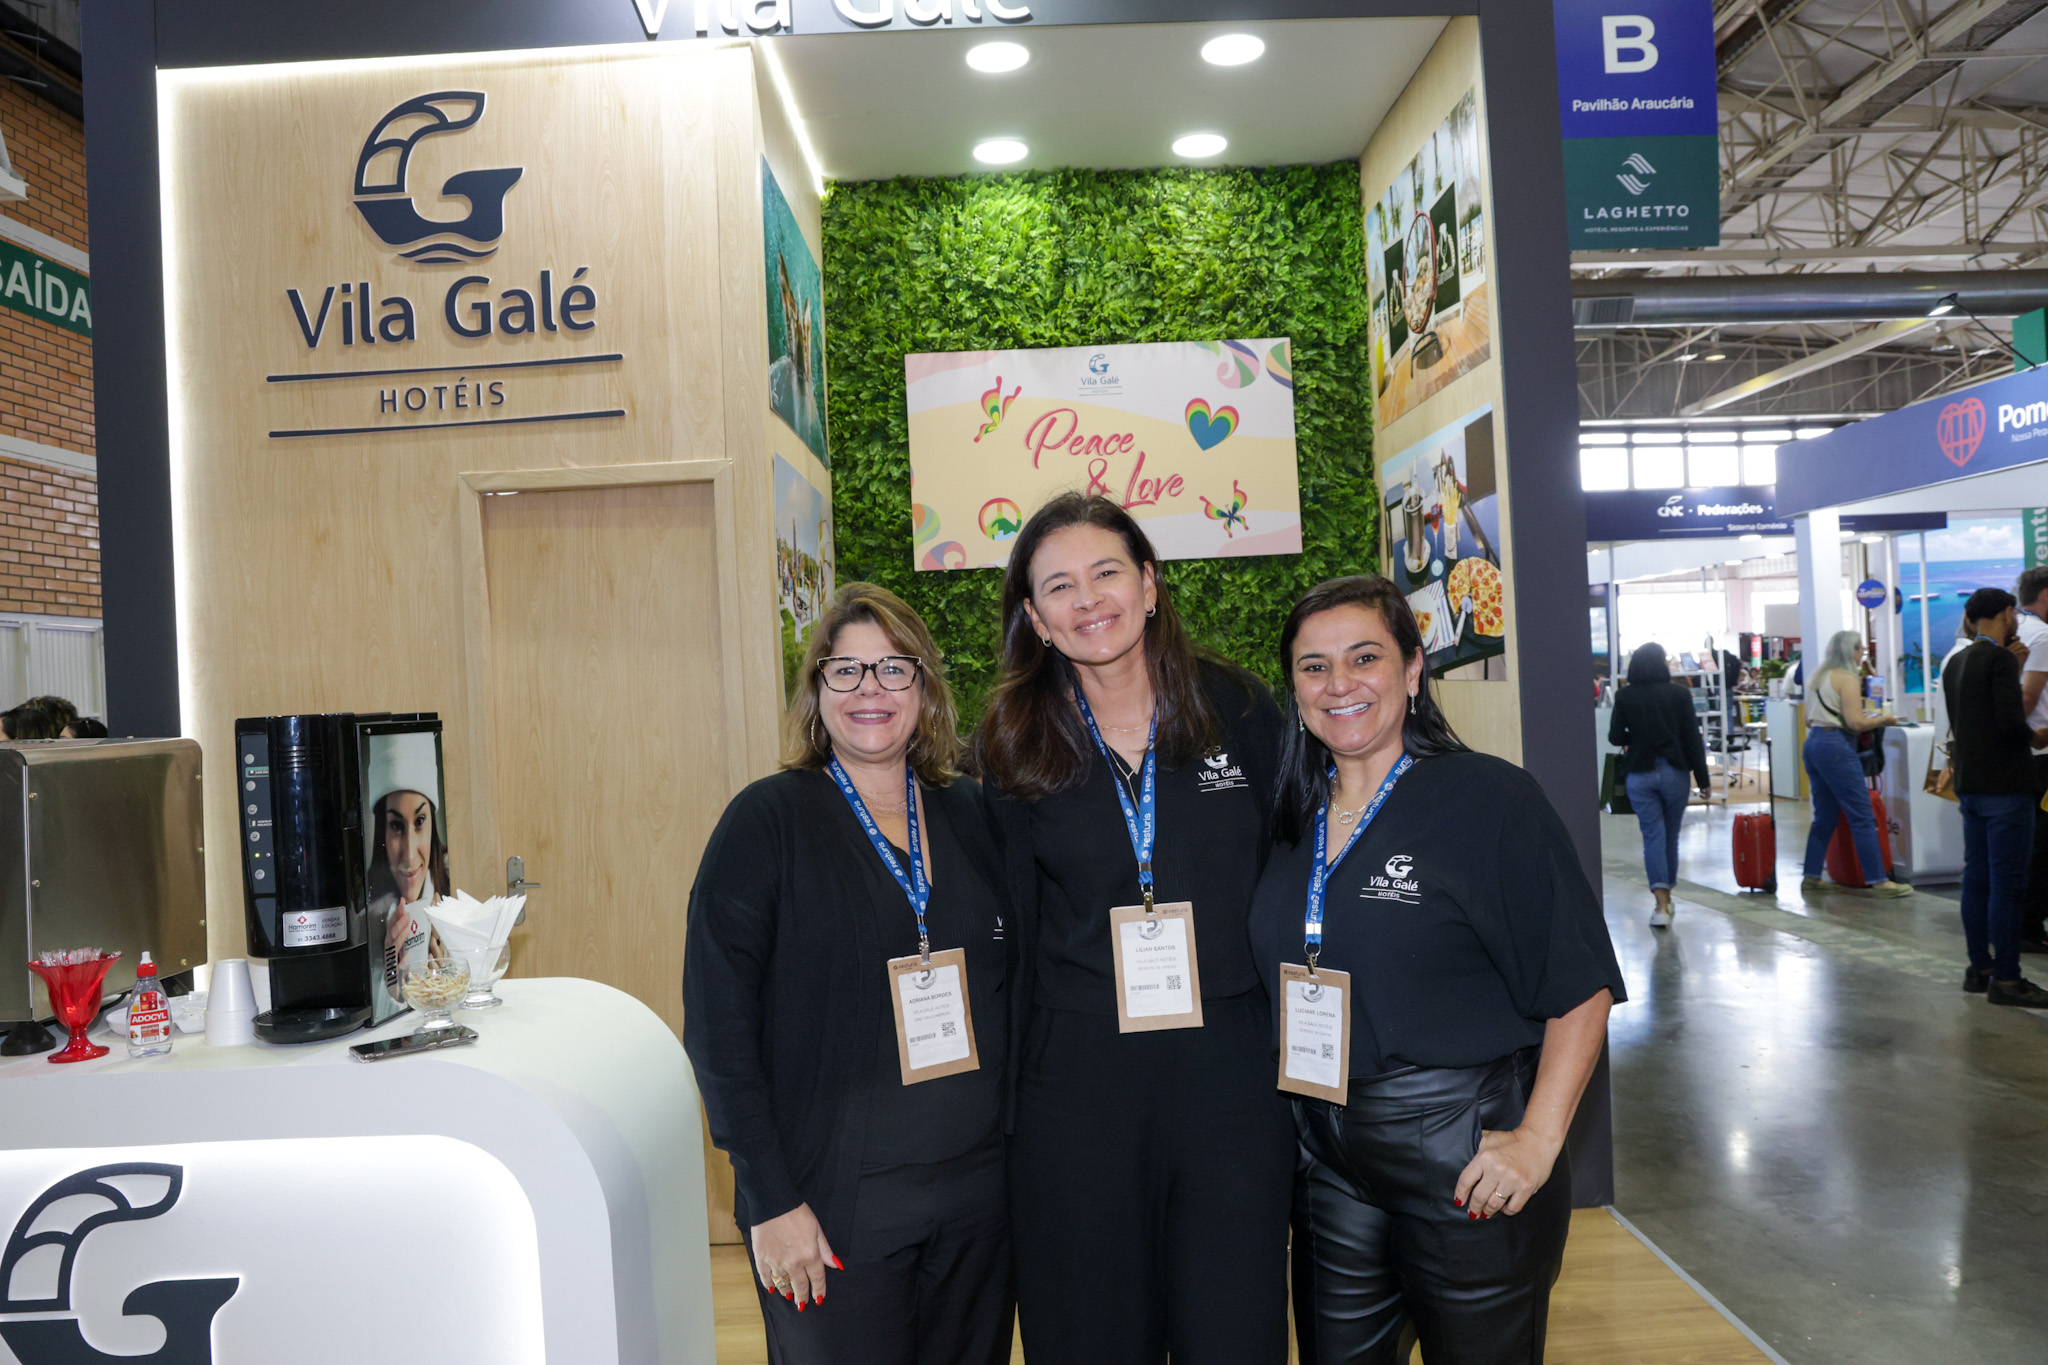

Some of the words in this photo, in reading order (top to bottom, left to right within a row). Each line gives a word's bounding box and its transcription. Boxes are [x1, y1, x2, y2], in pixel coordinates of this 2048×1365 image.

[1602, 14, 1659, 74] B
[1572, 97, 1628, 112] Pavilhão
[1631, 96, 1694, 110] Araucária
[1584, 205, 1689, 219] LAGHETTO
[286, 281, 416, 349] Vila
[445, 266, 597, 338] Galé
[1080, 377, 1097, 385] Vila
[1100, 376, 1119, 385] Galé
[380, 376, 505, 413] HOTÉIS
[1998, 401, 2048, 433] Pom
[1025, 408, 1135, 469] Peace
[1086, 458, 1112, 496] &
[1121, 451, 1184, 510] Love
[1657, 503, 1684, 517] CNC
[1697, 502, 1764, 517] Federações
[1198, 770, 1219, 781] Vila
[1221, 766, 1242, 777] Galé
[853, 800, 873, 827] Festuris
[910, 826, 919, 853] Festuris
[1143, 812, 1152, 847] Festuris
[878, 841, 899, 868] Festuris
[915, 867, 926, 893] Festuris
[1370, 876, 1389, 887] Vila
[1392, 879, 1418, 891] Galé
[909, 996, 930, 1004] ADRIANA
[1295, 1008, 1316, 1016] LUCIANE
[1316, 1010, 1336, 1018] LORENA
[132, 1012, 167, 1023] ADOCYL
